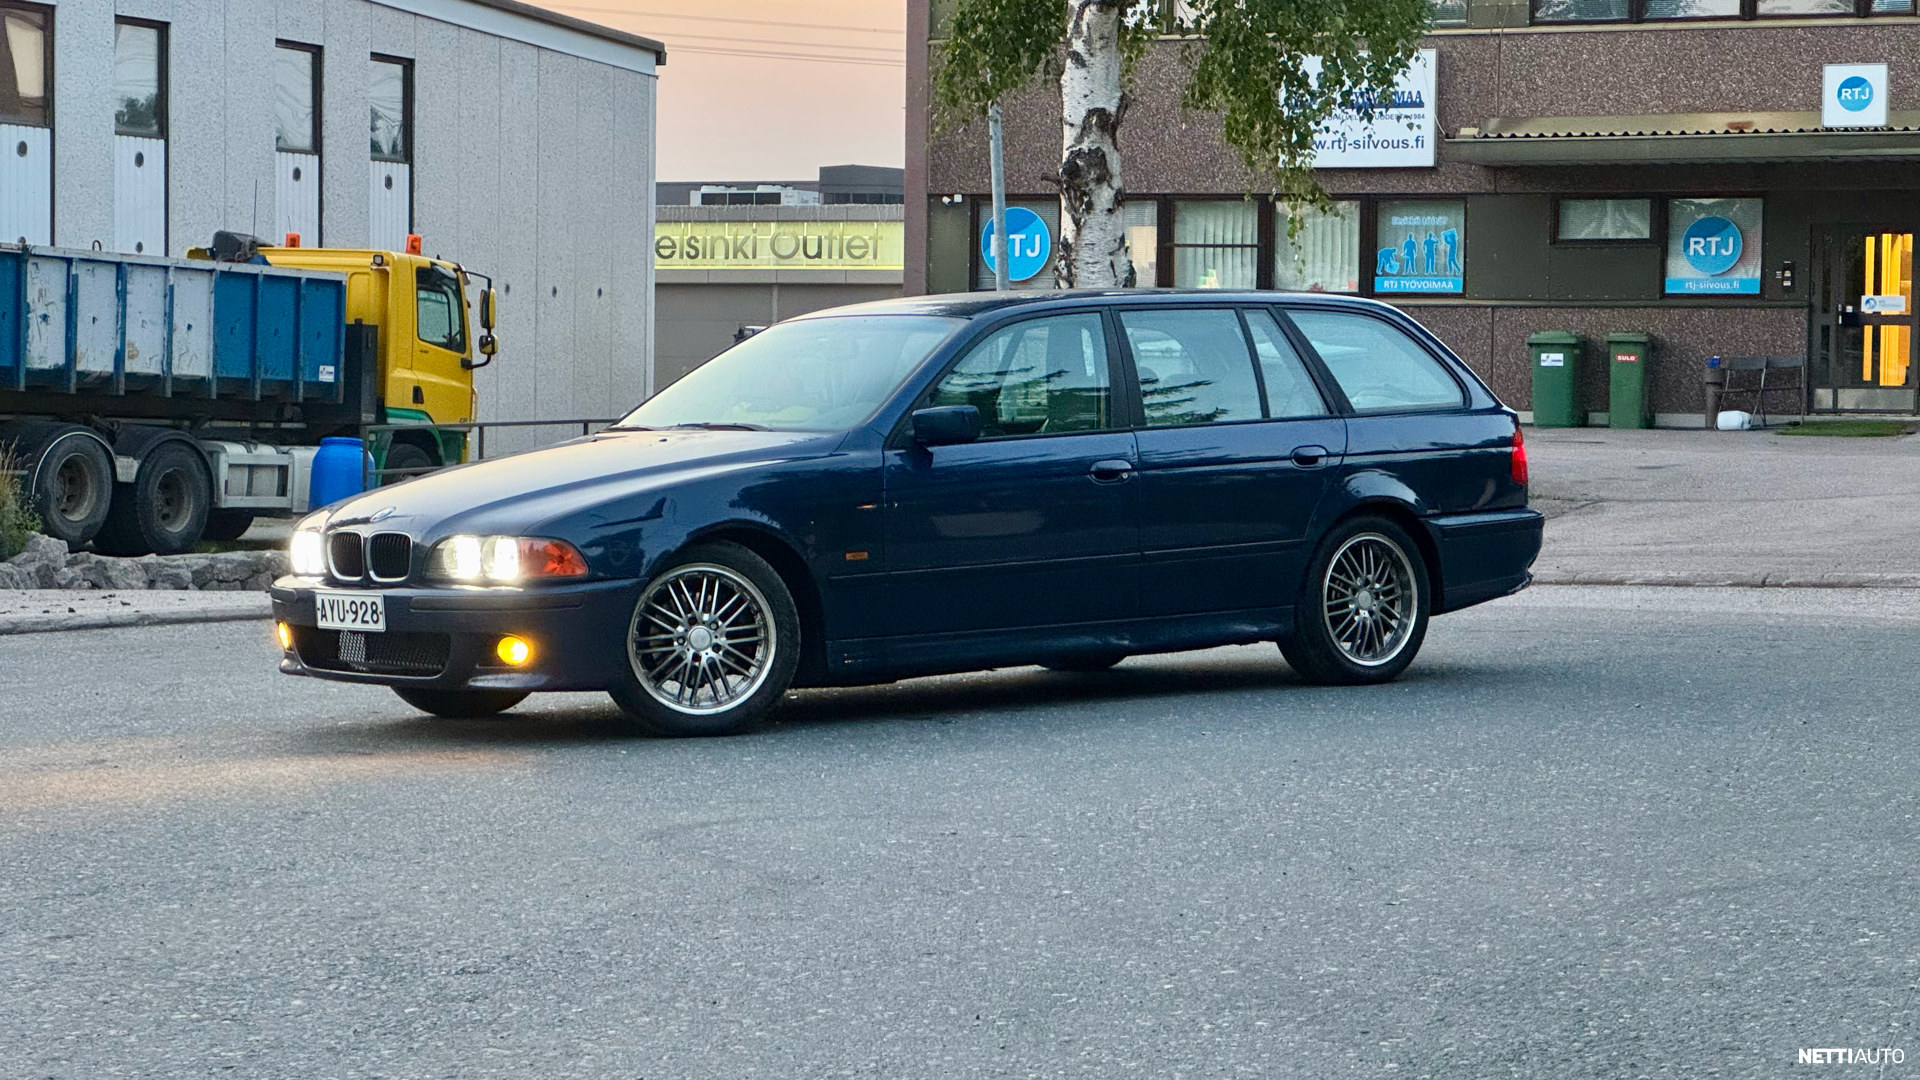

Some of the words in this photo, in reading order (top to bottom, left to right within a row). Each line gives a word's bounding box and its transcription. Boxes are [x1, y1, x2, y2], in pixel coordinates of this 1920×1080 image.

[1841, 87, 1870, 100] RTJ
[1314, 135, 1425, 153] w.rtj-siivous.fi
[655, 228, 759, 260] elsinki
[769, 228, 883, 260] Outlet
[1689, 236, 1734, 256] RTJ
[1384, 280, 1398, 289] RTJ
[1400, 279, 1454, 289] TYÖVOIMAA
[1685, 280, 1740, 291] rtj-siivous.fi
[320, 598, 380, 625] AYU-928
